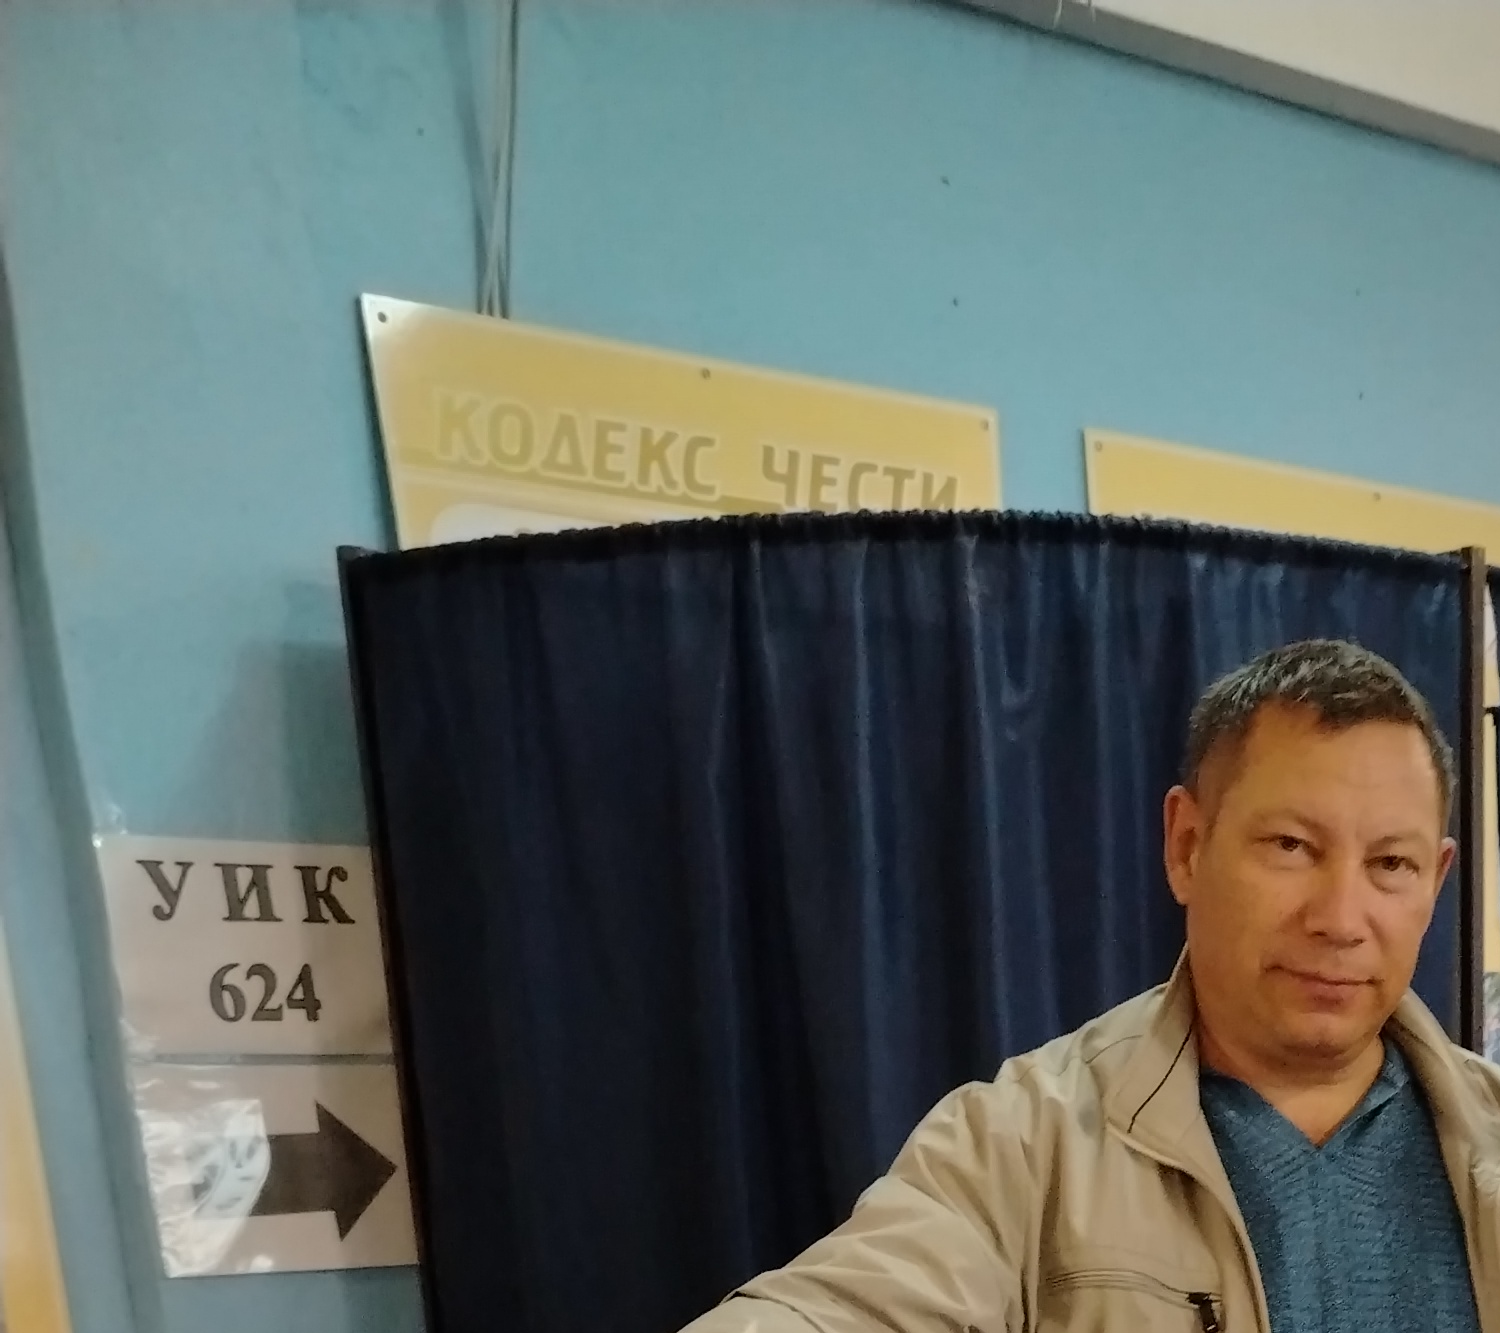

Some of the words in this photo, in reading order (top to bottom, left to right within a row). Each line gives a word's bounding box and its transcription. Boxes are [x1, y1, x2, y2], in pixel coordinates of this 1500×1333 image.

[437, 393, 718, 497] КОДЕКС
[761, 445, 958, 512] ЧЕСТИ
[209, 962, 322, 1023] 624
